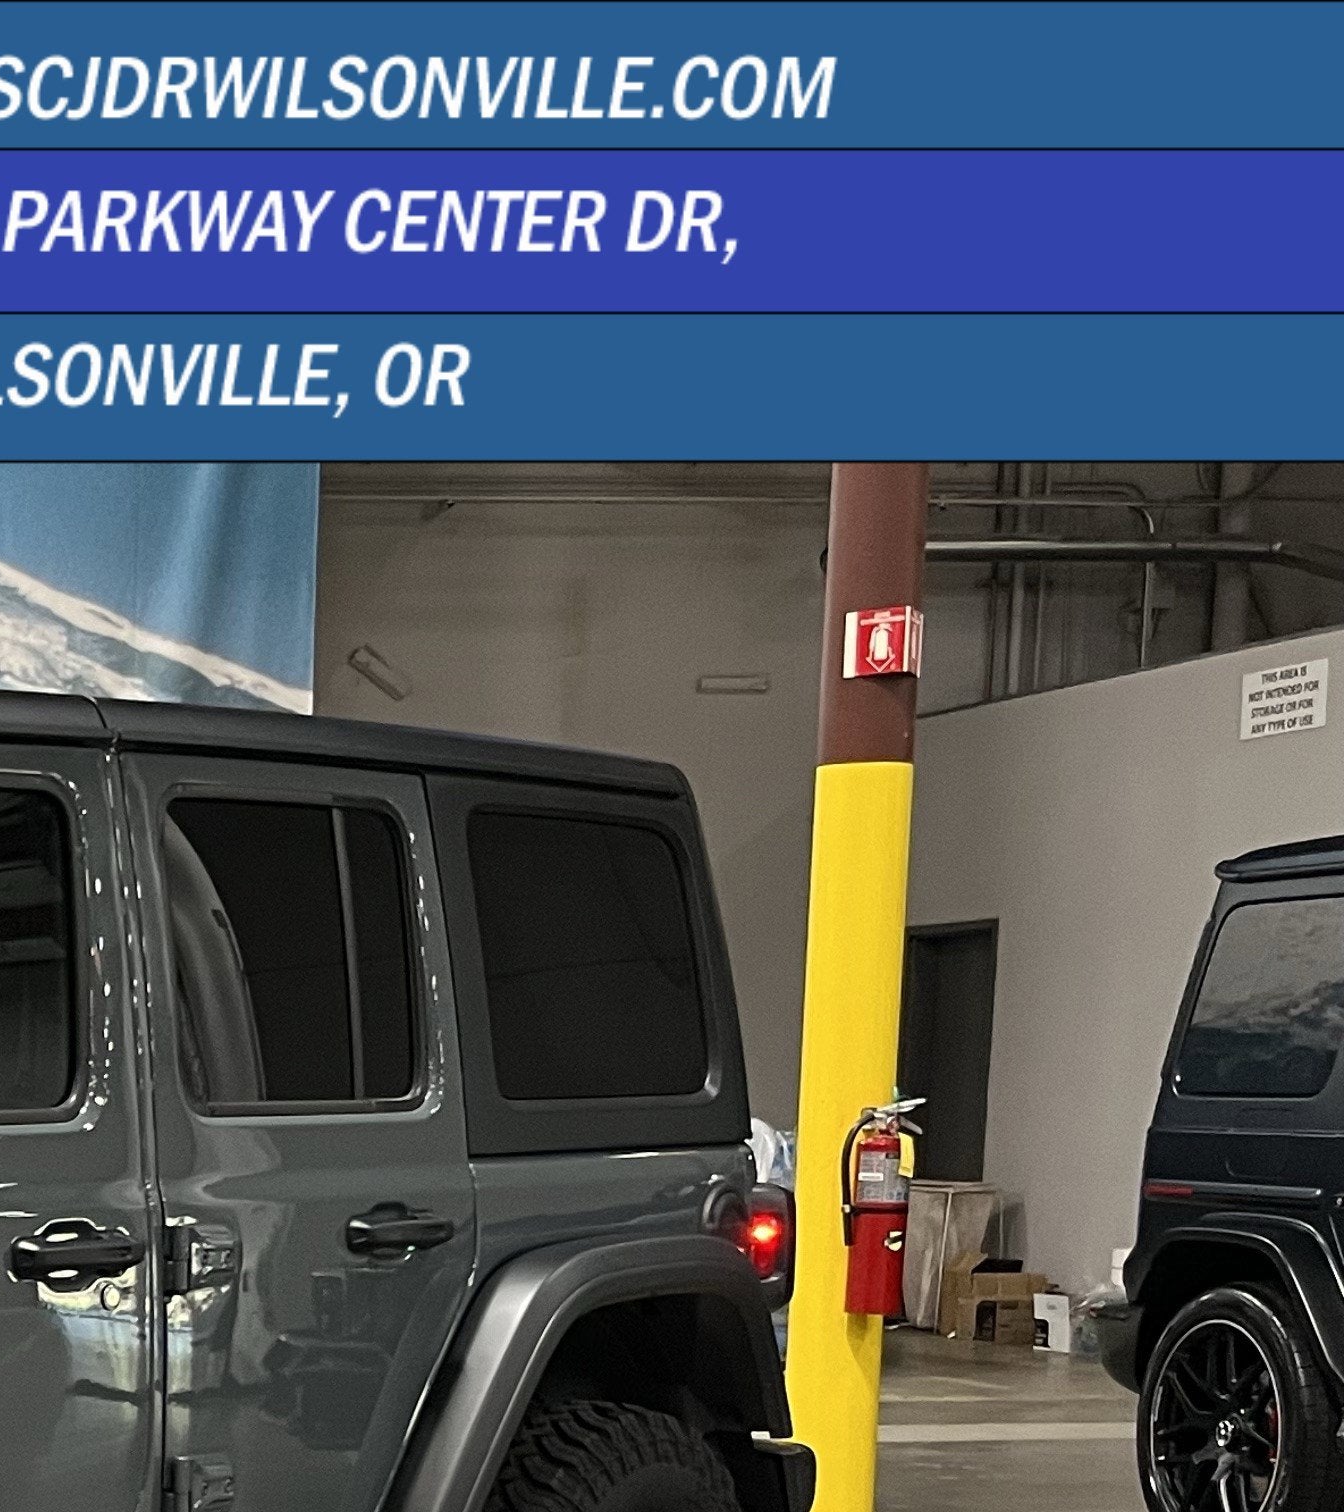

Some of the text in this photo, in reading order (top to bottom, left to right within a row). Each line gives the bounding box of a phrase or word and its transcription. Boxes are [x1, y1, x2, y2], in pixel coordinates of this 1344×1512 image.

[1303, 680, 1319, 692] FOR
[1298, 698, 1313, 710] FOR
[1287, 717, 1297, 729] OF
[1299, 715, 1313, 726] USE
